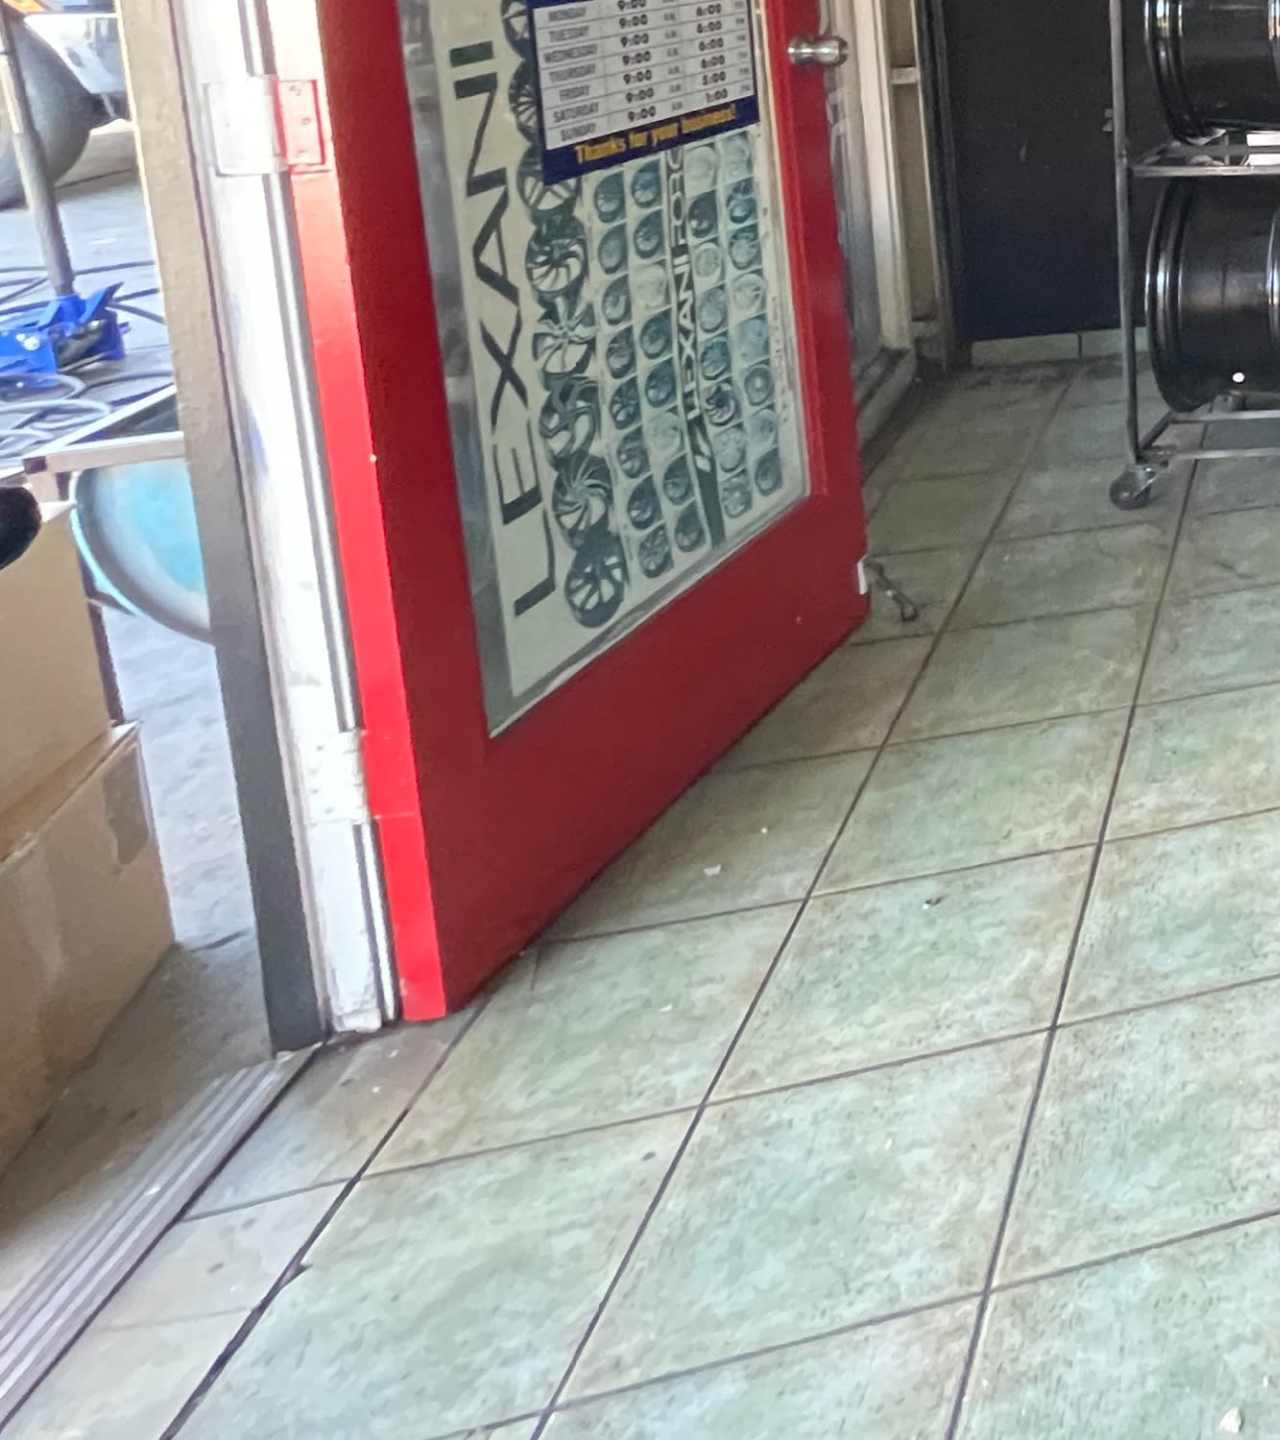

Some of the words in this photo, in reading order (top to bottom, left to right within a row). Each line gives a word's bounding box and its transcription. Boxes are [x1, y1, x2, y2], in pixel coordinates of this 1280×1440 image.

[619, 14, 648, 29] 9:00
[621, 33, 650, 48] 9:00
[622, 51, 652, 67] 9:00
[623, 69, 653, 85] 9:00
[625, 87, 655, 103] 9:00
[627, 105, 657, 122] 9:00
[575, 137, 627, 165] Thanks
[449, 40, 556, 620] LEXANI
